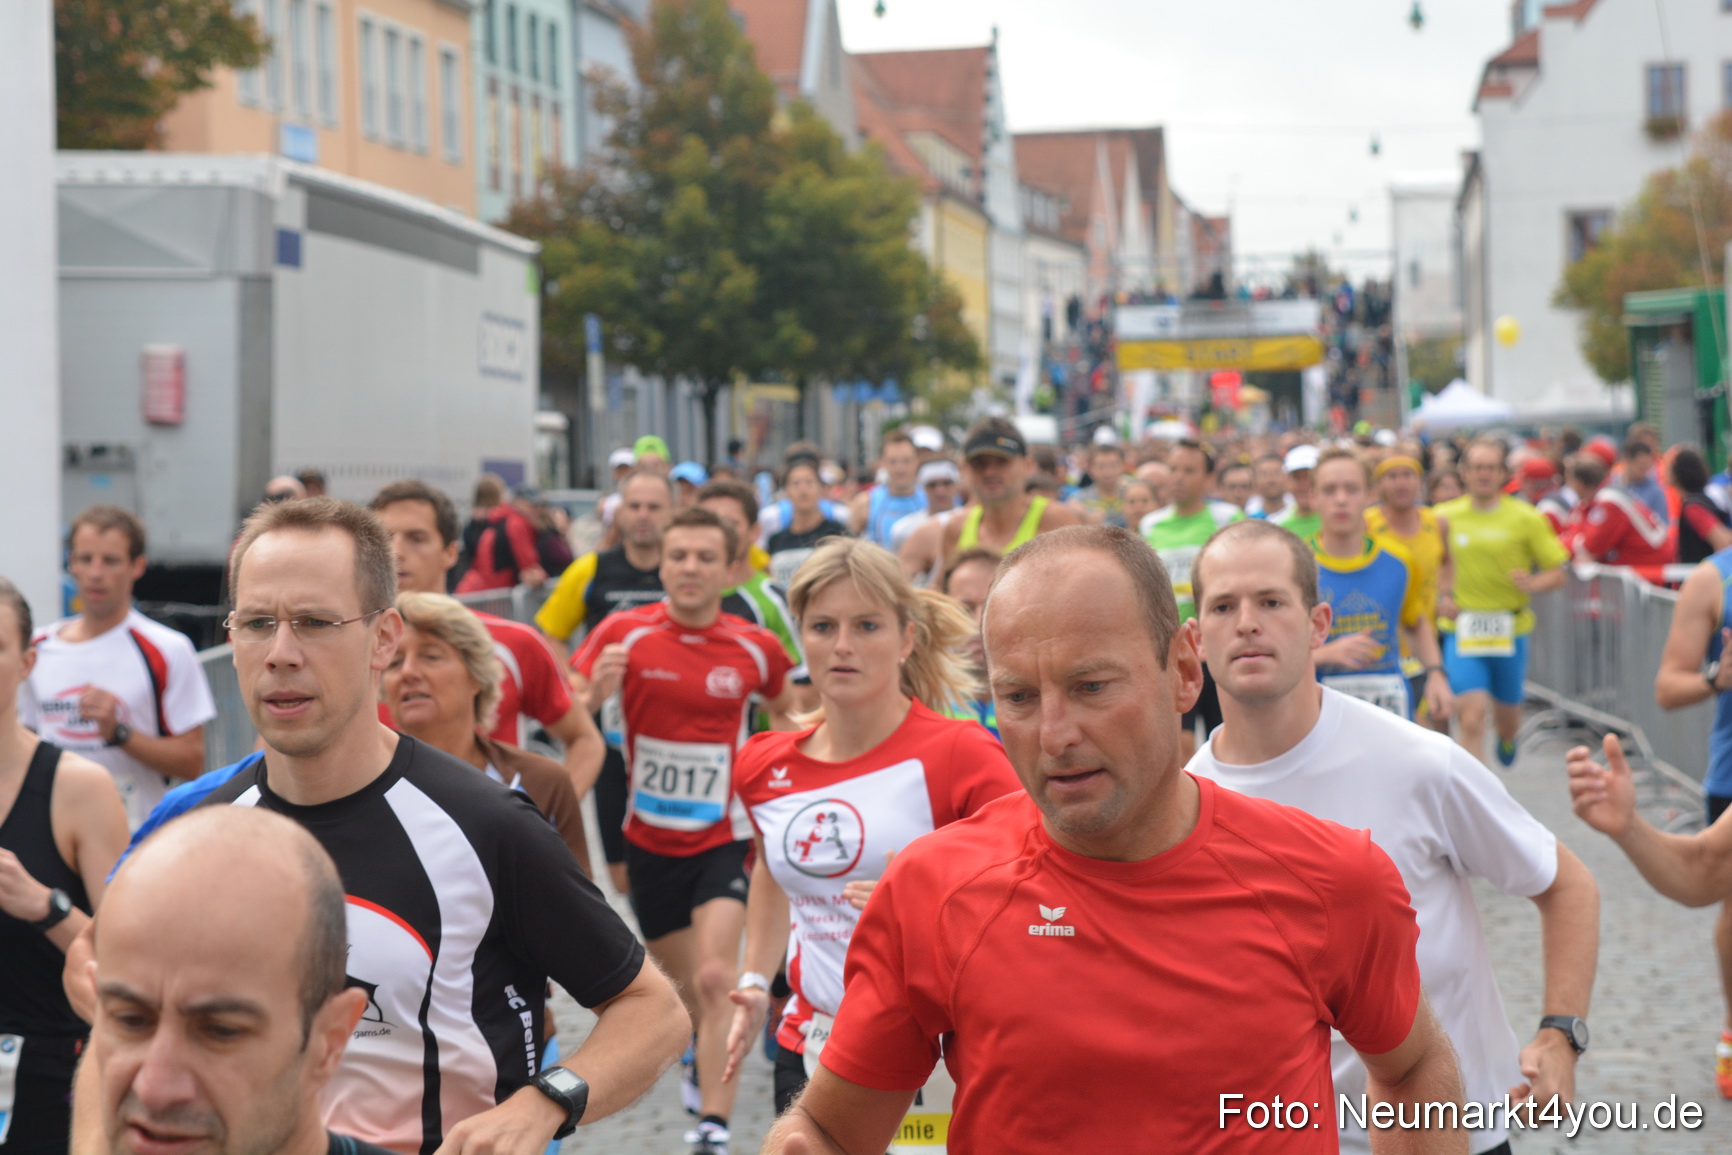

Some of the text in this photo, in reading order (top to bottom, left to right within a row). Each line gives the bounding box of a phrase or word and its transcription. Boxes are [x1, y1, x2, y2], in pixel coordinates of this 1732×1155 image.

[643, 760, 719, 797] 2017
[1028, 923, 1075, 937] erima
[504, 984, 526, 1010] FC
[899, 1119, 935, 1140] nie
